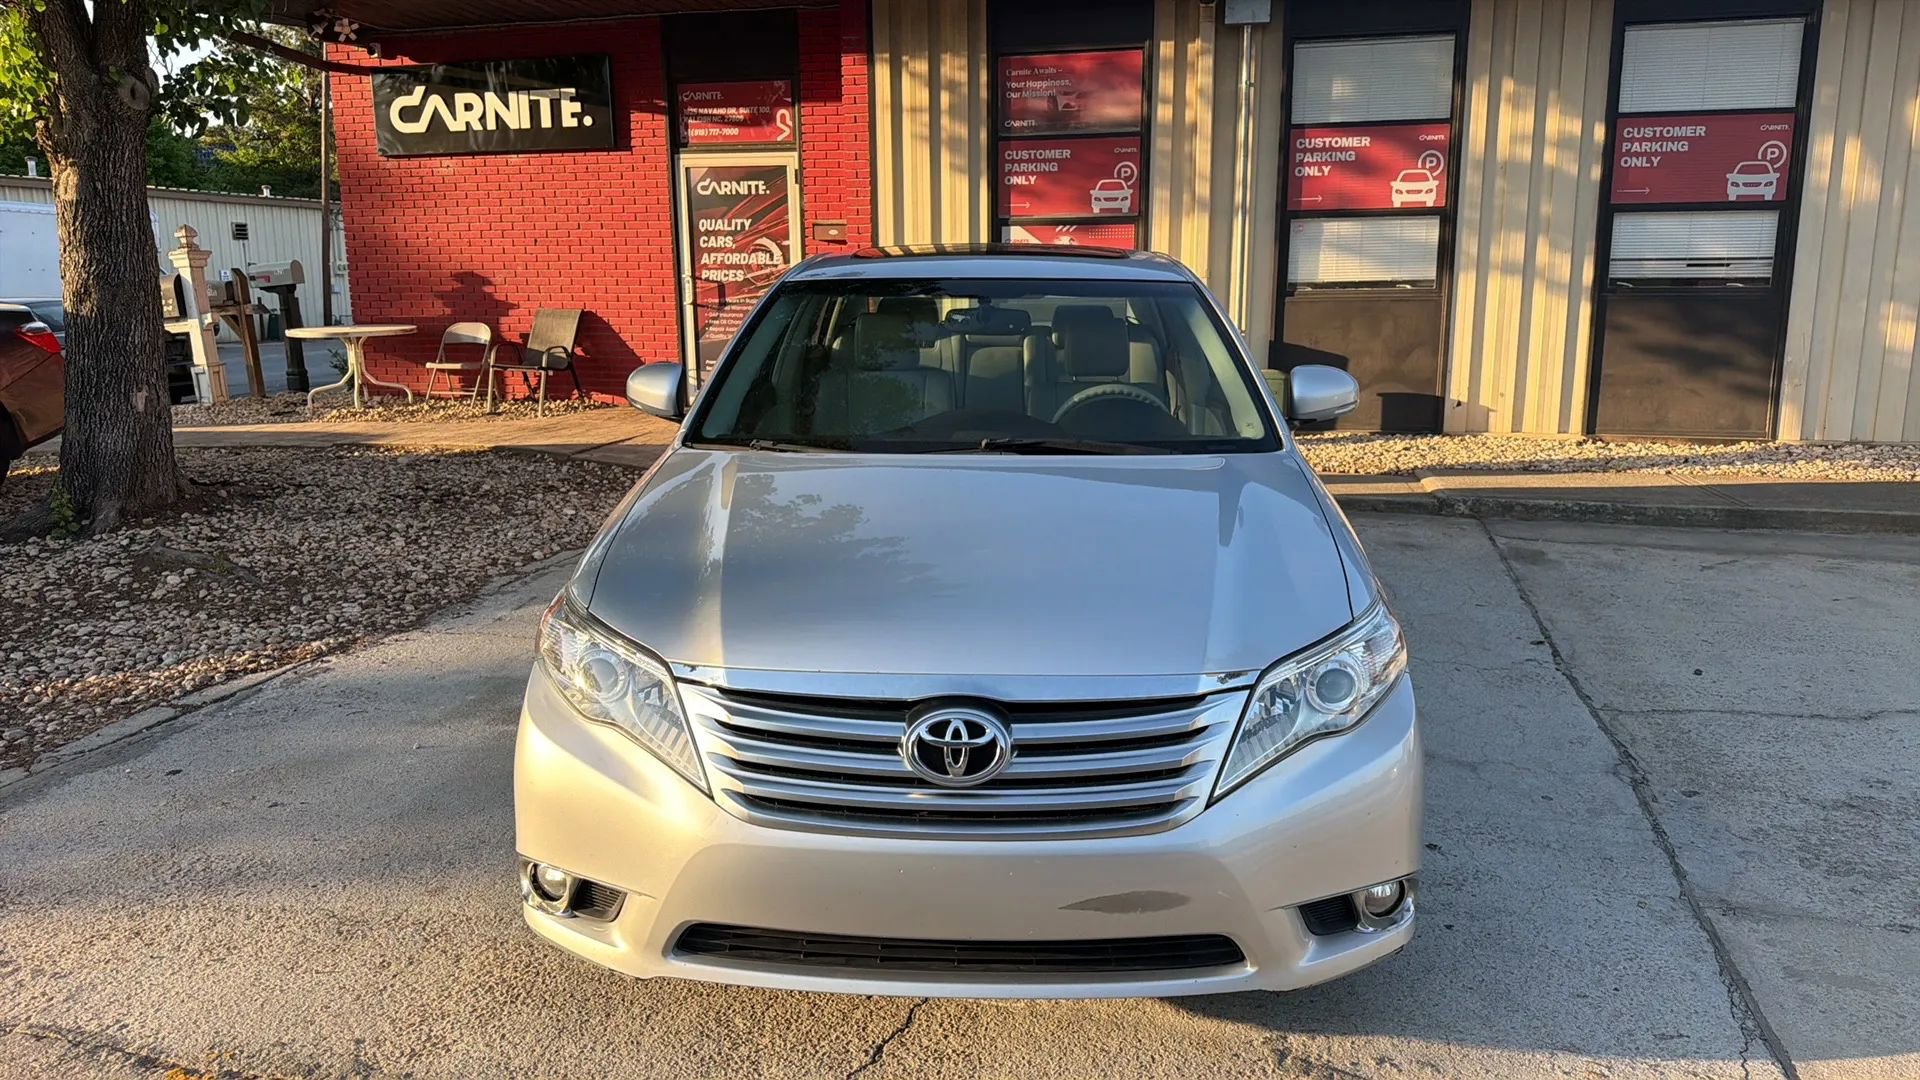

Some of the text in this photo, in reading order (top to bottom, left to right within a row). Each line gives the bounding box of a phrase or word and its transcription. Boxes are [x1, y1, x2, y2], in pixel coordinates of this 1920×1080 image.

[1033, 67, 1057, 75] Awaits
[1006, 79, 1072, 89] Your Happiness,
[1006, 88, 1056, 99] Our Mission!
[389, 85, 593, 134] CARNITE.
[698, 107, 726, 115] NAVAHO
[1623, 126, 1706, 138] CUSTOMER
[1296, 136, 1371, 149] CUSTOMER
[1621, 141, 1689, 153] PARKING
[1004, 149, 1071, 160] CUSTOMER
[1295, 151, 1356, 163] PARKING
[1004, 162, 1058, 172] PARKING
[1620, 156, 1661, 168] ONLY
[1295, 165, 1331, 177] ONLY
[1004, 175, 1037, 185] ONLY
[697, 178, 770, 195] CARNITE.
[699, 218, 752, 232] QUALITY
[700, 235, 736, 250] CARS,
[701, 252, 783, 265] AFFORDABLE
[701, 269, 744, 281] PRICES
